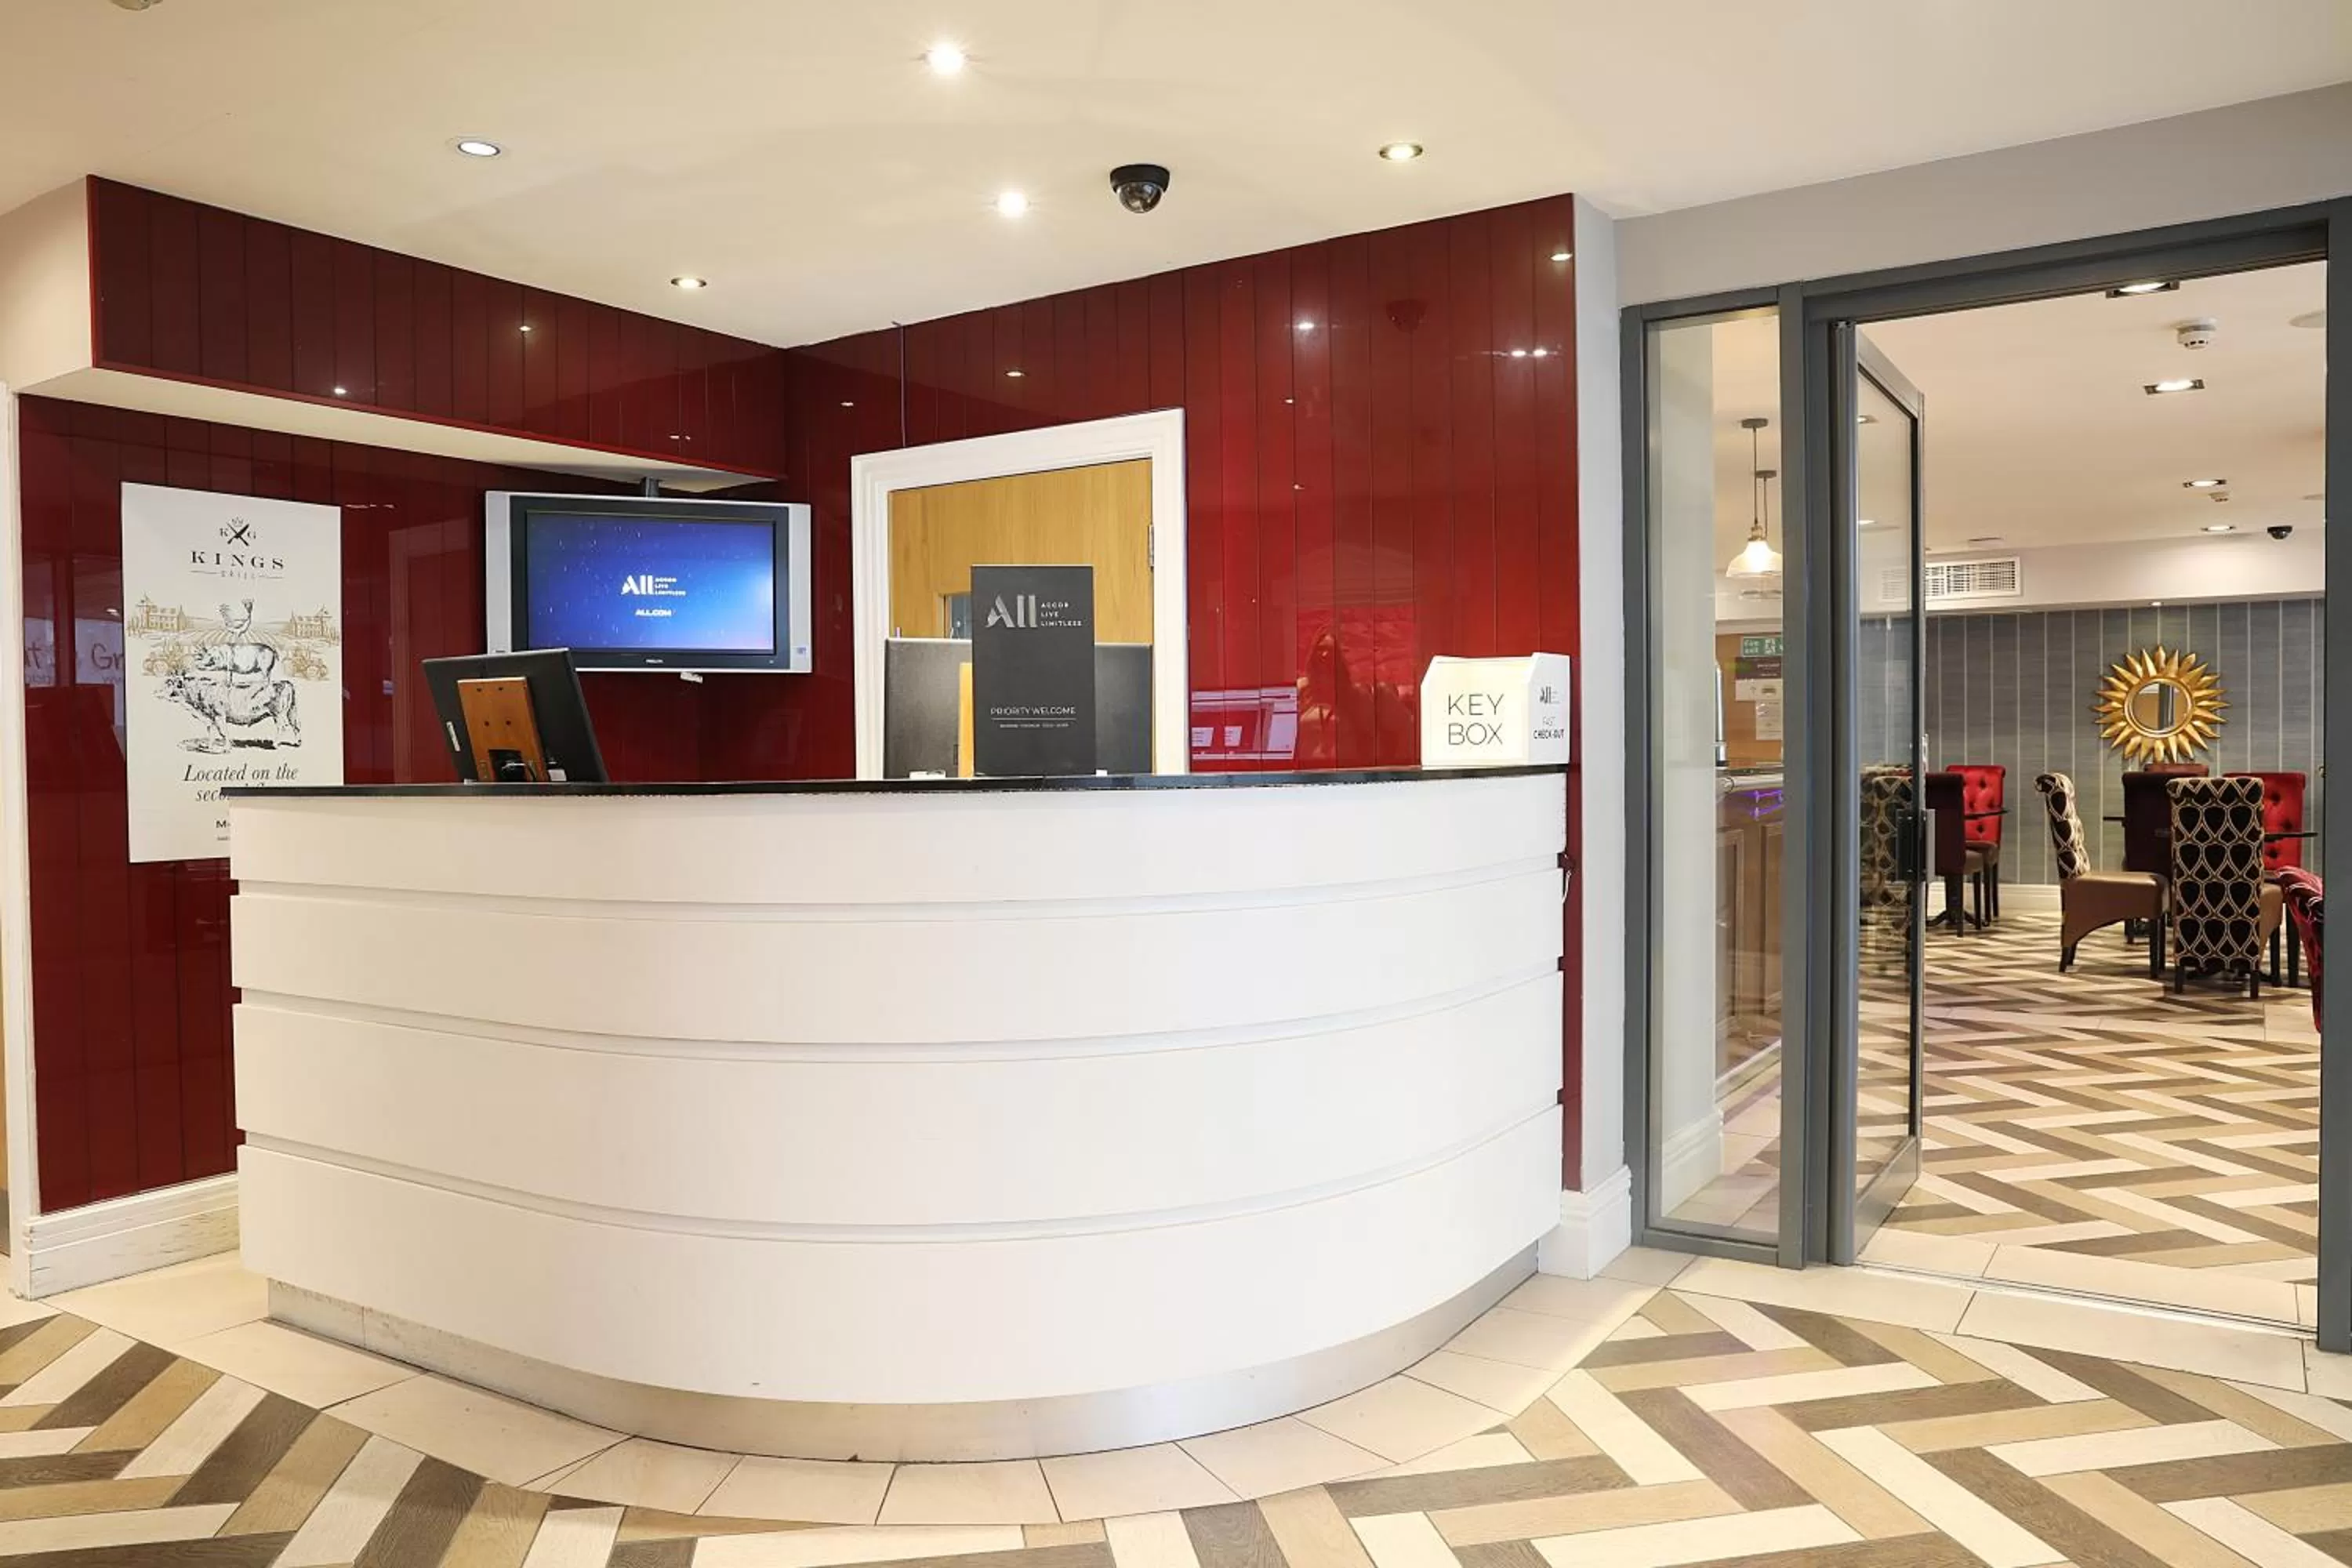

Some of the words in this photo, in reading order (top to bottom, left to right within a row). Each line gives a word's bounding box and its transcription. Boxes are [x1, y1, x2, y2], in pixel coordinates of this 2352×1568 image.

[191, 550, 285, 570] KINGS
[634, 608, 673, 617] ALL.COM
[990, 706, 1030, 715] PRIORITY
[1031, 706, 1076, 715] WELCOME
[1448, 693, 1504, 716] KEY
[1448, 722, 1503, 746] BOX
[1533, 728, 1565, 740] CHECK-OUT
[183, 764, 249, 782] Located
[251, 768, 270, 780] on
[275, 762, 298, 780] the
